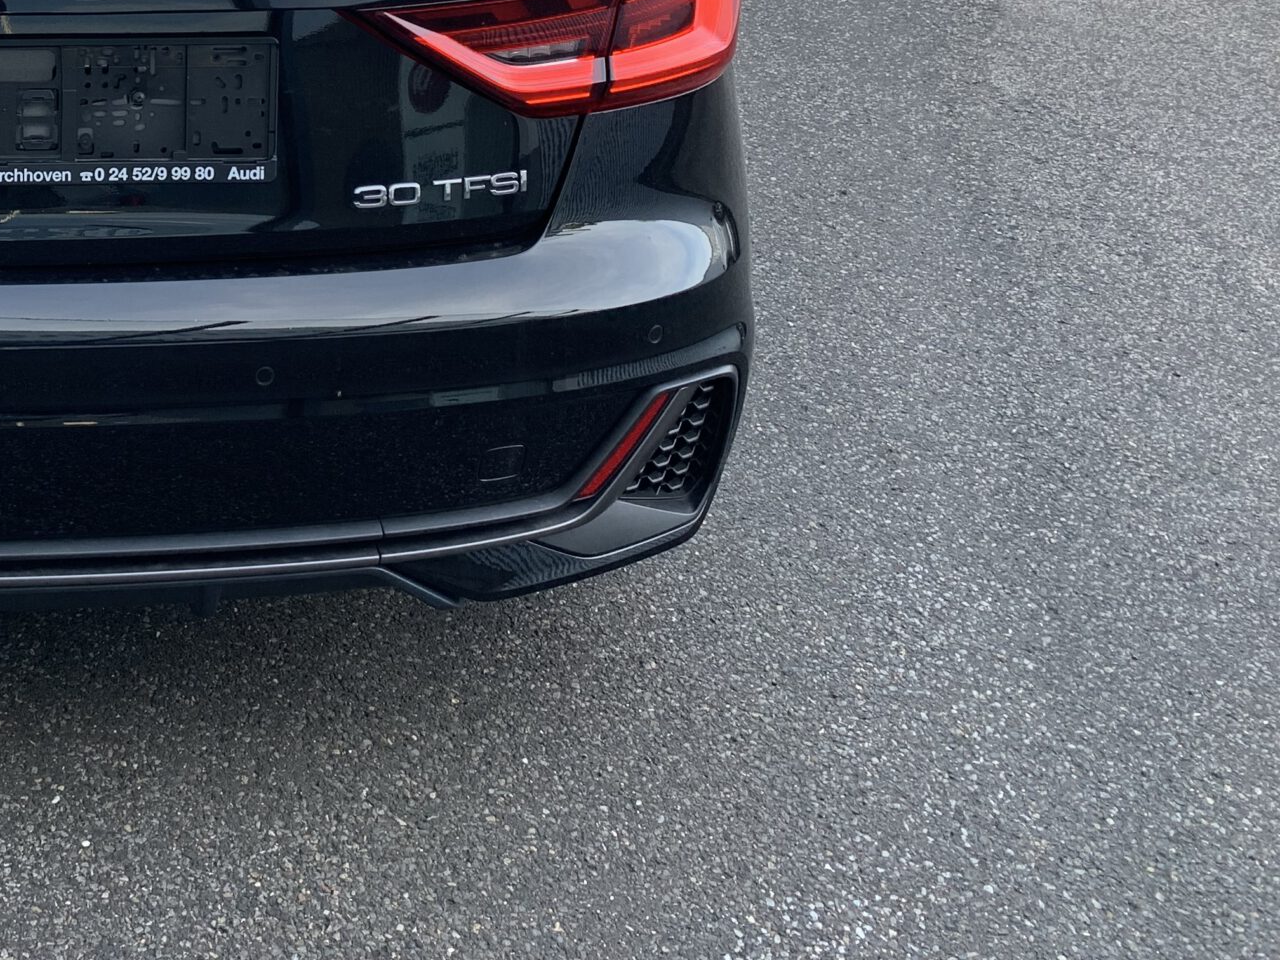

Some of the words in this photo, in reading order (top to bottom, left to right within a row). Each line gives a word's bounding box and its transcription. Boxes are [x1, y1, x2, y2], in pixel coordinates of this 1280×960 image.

[108, 167, 129, 182] 24
[131, 167, 168, 181] 52/9
[170, 167, 191, 181] 99
[194, 166, 215, 181] 80
[227, 166, 265, 180] Audi
[353, 181, 421, 209] 30
[432, 169, 528, 202] TFSI
